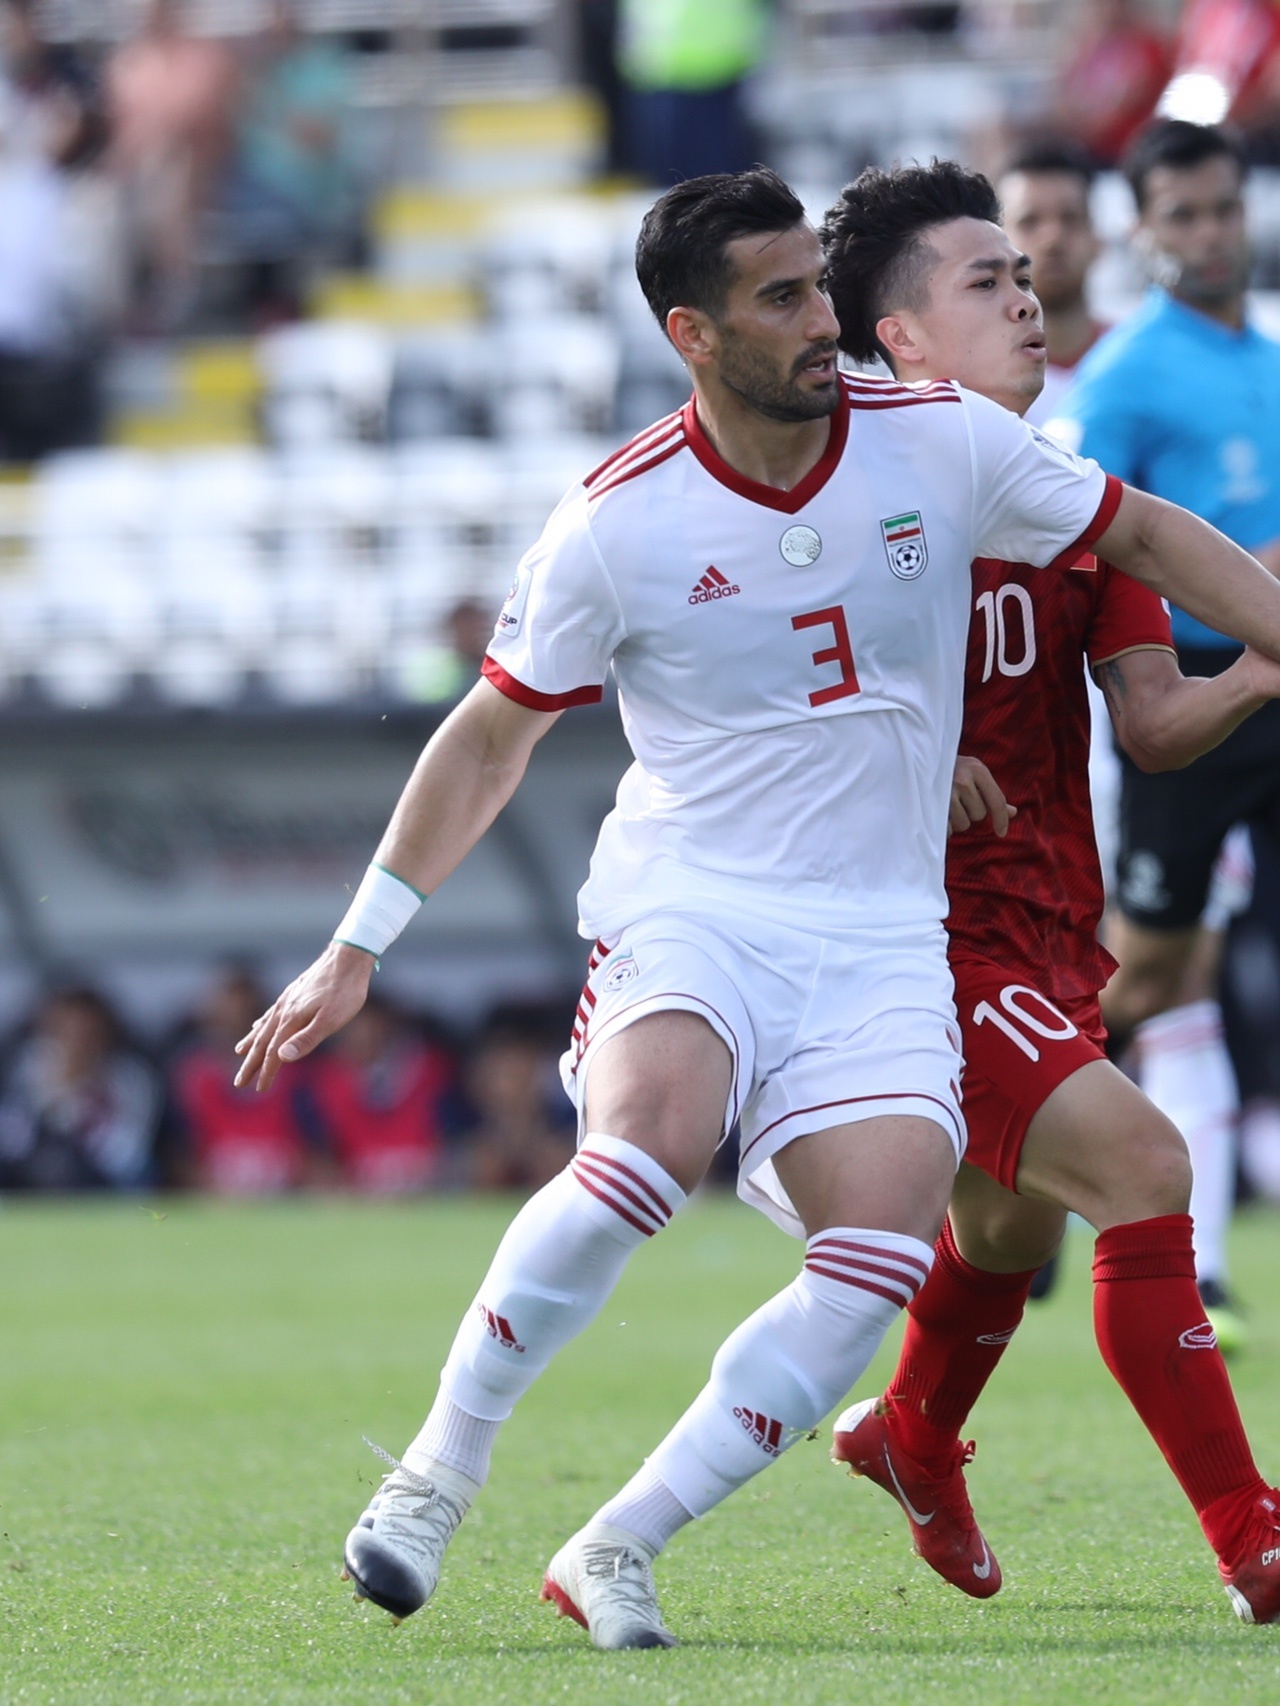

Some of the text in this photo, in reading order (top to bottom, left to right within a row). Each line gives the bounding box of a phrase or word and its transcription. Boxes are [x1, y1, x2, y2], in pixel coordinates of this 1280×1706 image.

[687, 584, 741, 606] adidas
[975, 582, 1037, 684] 10
[790, 604, 862, 708] 3
[972, 984, 1079, 1063] 10
[732, 1406, 781, 1458] adidas
